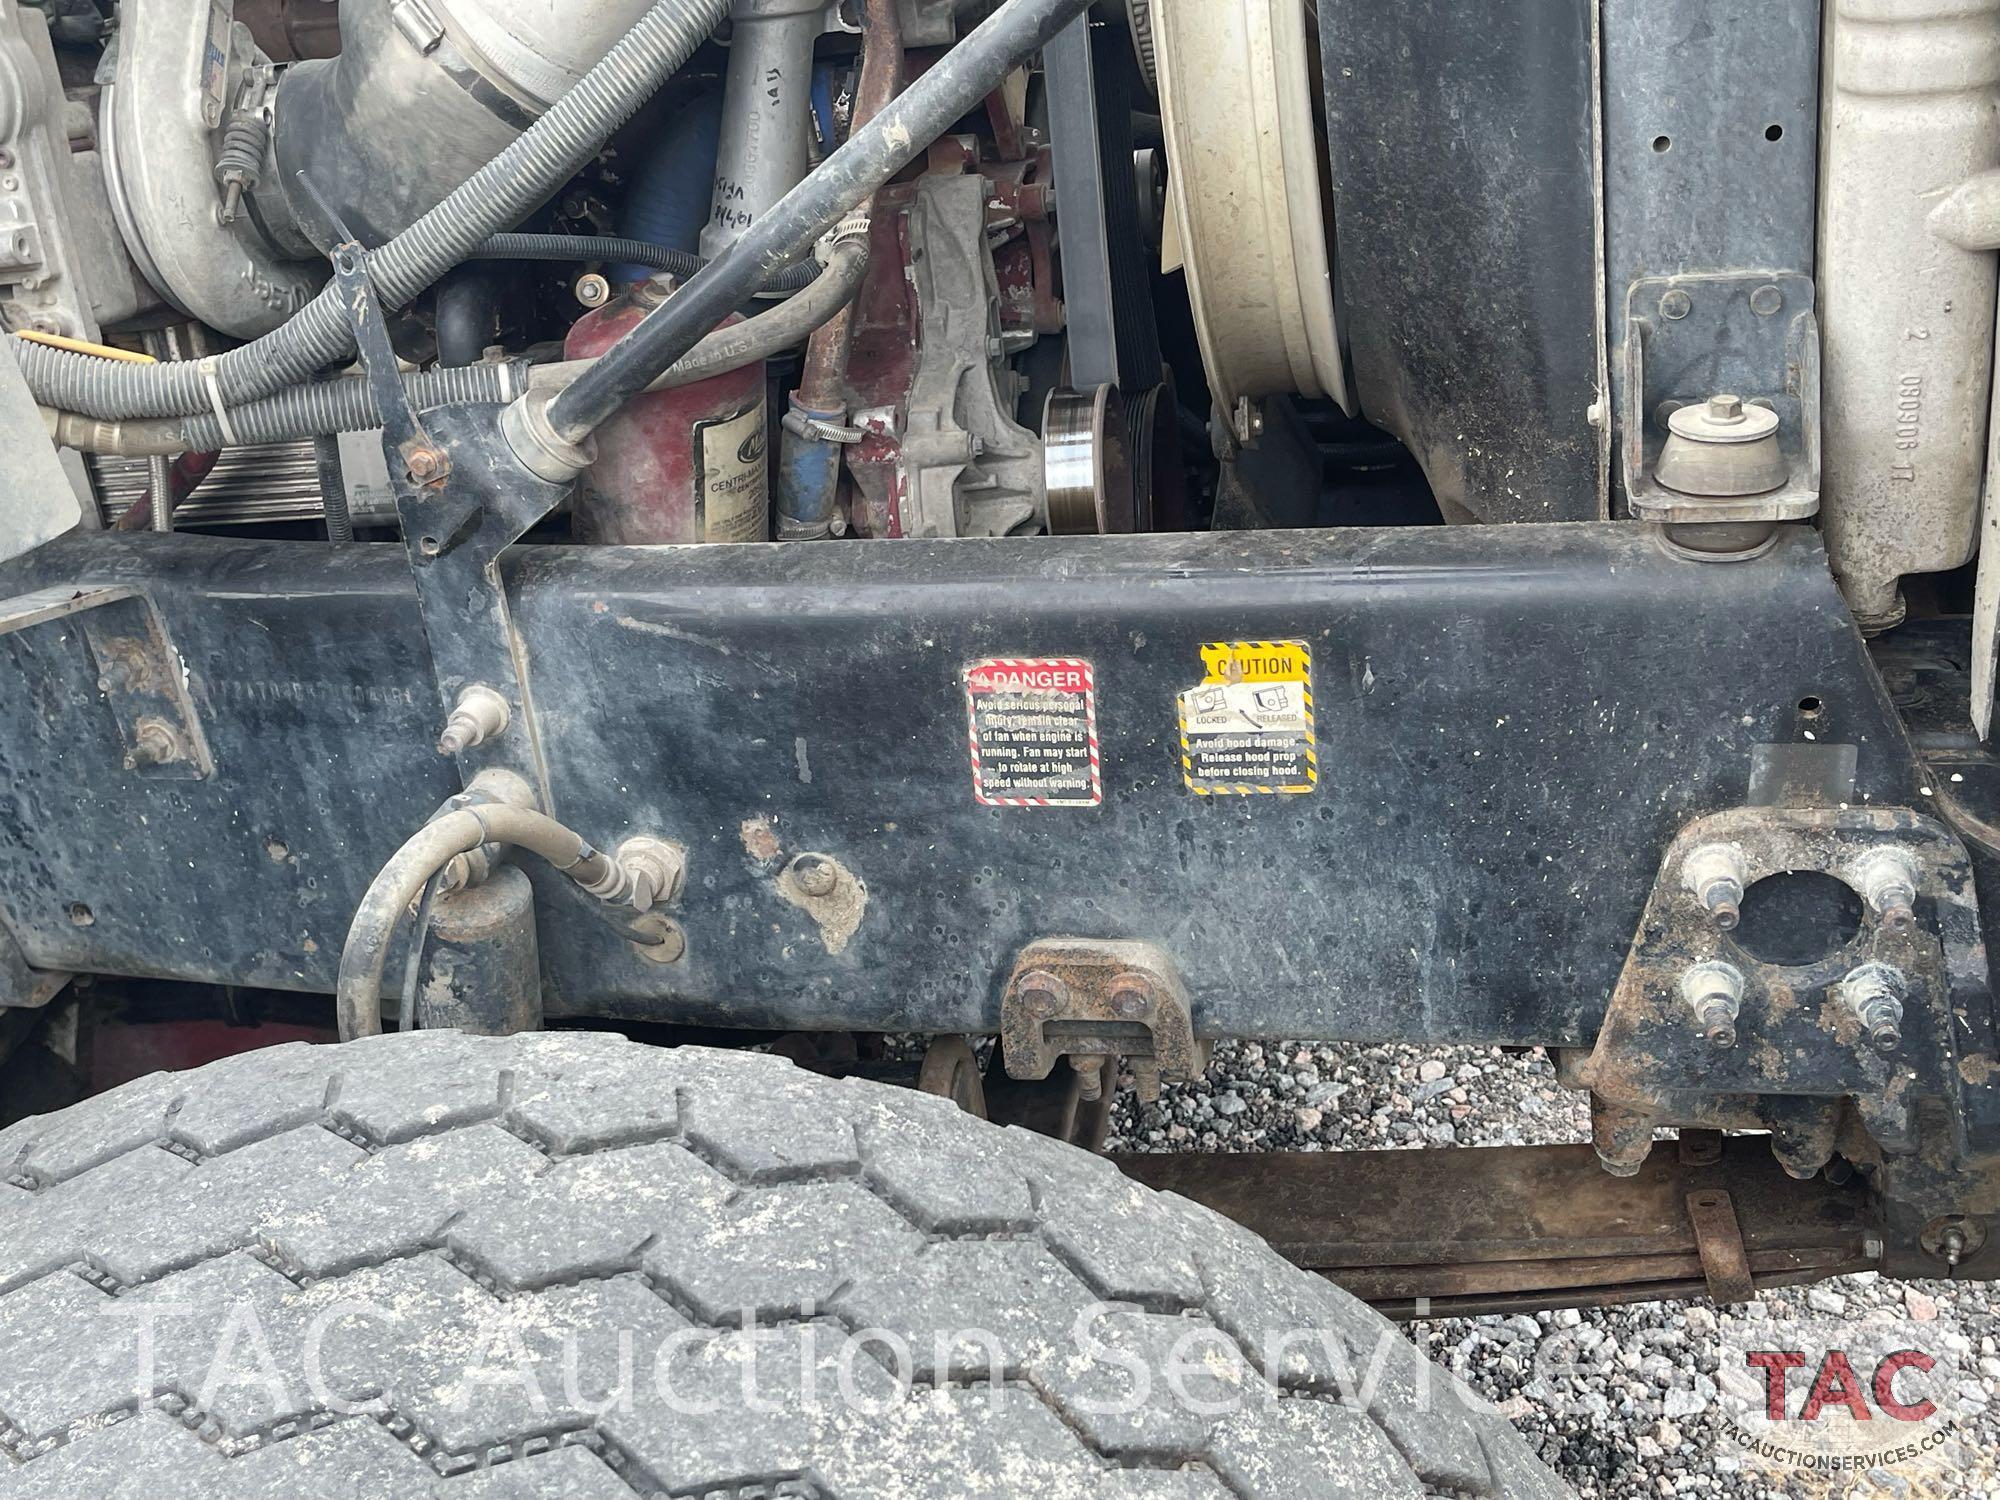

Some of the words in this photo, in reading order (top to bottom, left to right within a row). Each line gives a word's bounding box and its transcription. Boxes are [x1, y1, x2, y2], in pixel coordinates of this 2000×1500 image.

[1904, 326, 1931, 342] 2
[672, 358, 708, 374] Made
[1217, 657, 1293, 676] CAUTION
[992, 670, 1082, 688] DANGER
[976, 699, 1002, 711] Avoid
[1005, 700, 1041, 712] serious
[1043, 699, 1085, 713] personal
[1053, 714, 1079, 727] clear
[1196, 716, 1228, 725] LOCKED
[1256, 713, 1297, 723] RELEASED
[982, 730, 993, 742] of
[994, 730, 1009, 742] fan
[1011, 730, 1038, 742] when
[1039, 731, 1072, 745] engine
[1074, 732, 1083, 742] is
[1195, 738, 1223, 749] Avoid
[1226, 738, 1252, 749] hood
[1254, 737, 1300, 750] damage.
[981, 747, 1021, 760] running.
[1023, 746, 1041, 757] Fan
[1043, 748, 1063, 760] may
[1065, 747, 1088, 758] start
[1201, 752, 1243, 763] Release
[1245, 751, 1271, 762] hood
[1272, 751, 1296, 764] prop
[997, 763, 1008, 773] to
[1010, 762, 1038, 773] rotate
[1039, 763, 1050, 773] at
[1051, 762, 1073, 775] high
[1197, 767, 1230, 777] before
[1232, 766, 1270, 779] closing
[1272, 764, 1301, 777] hood.
[983, 777, 1011, 789] speed
[1012, 776, 1048, 788] without
[1049, 778, 1091, 791] warning.
